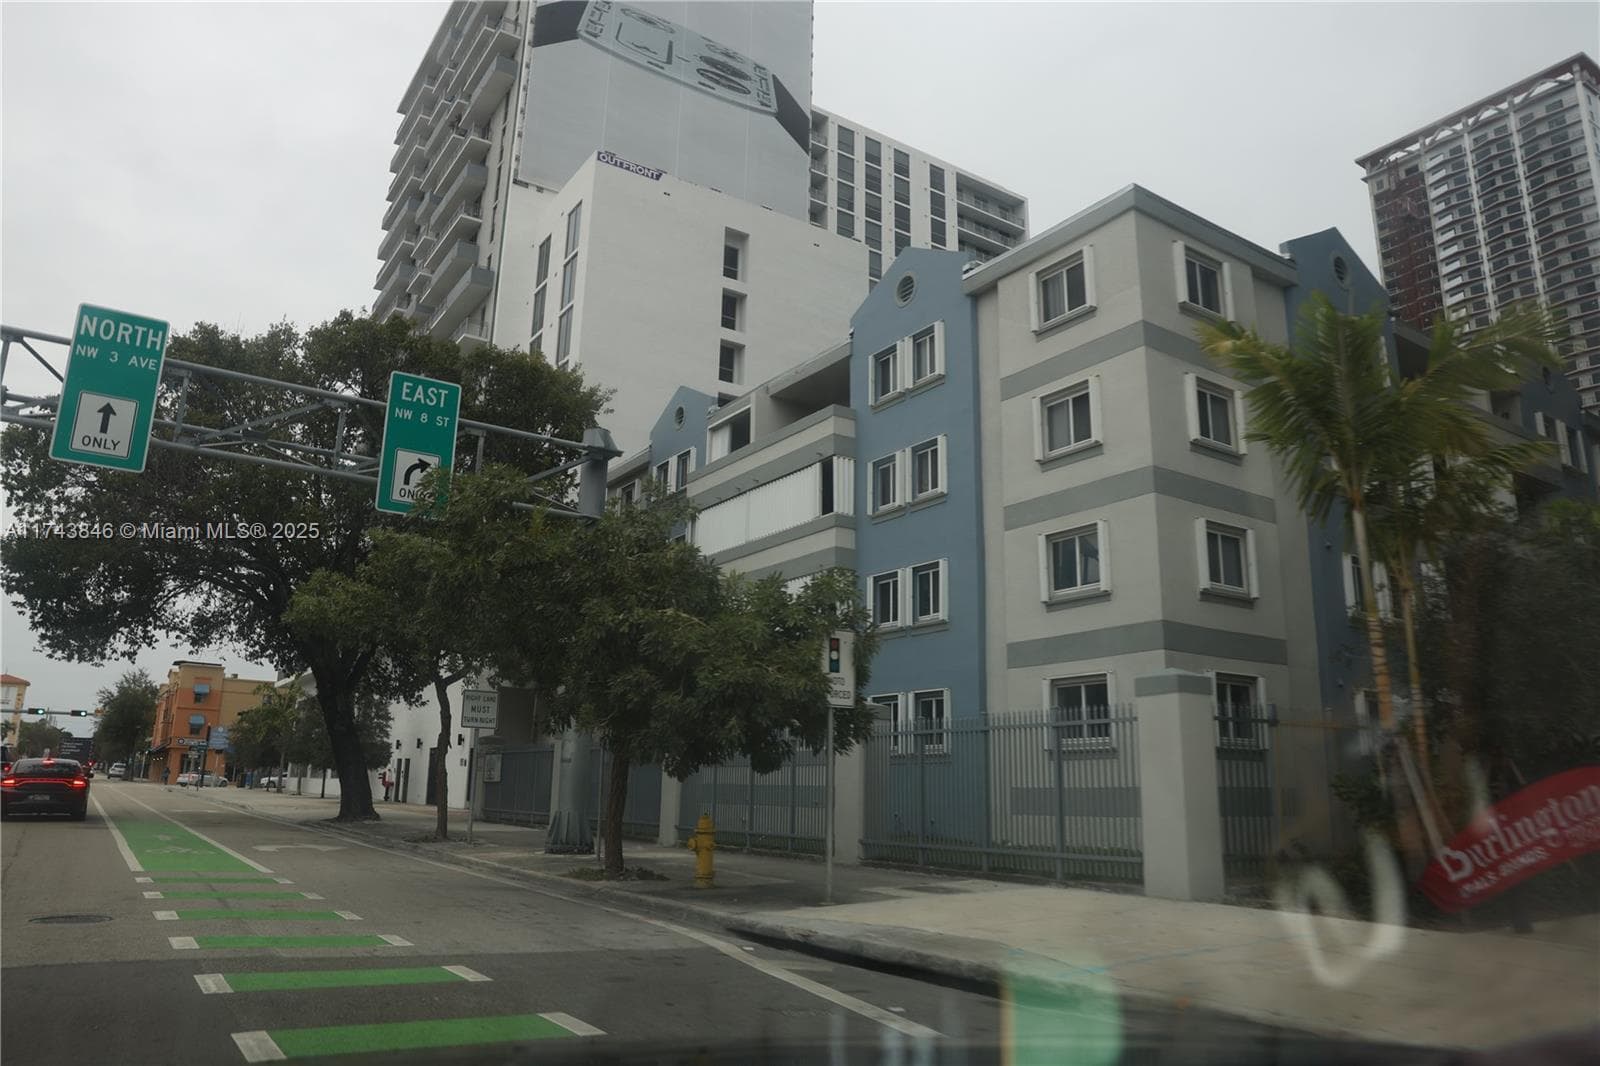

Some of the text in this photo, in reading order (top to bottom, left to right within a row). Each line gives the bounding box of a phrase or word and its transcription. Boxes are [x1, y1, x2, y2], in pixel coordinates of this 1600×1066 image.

[600, 153, 659, 179] OUTFRONT
[80, 314, 163, 350] NORTH
[75, 344, 158, 371] NW 3 AVE
[401, 381, 449, 408] EAST
[394, 407, 450, 428] NW 8 ST
[81, 435, 121, 451] ONLY
[471, 705, 490, 714] MUST
